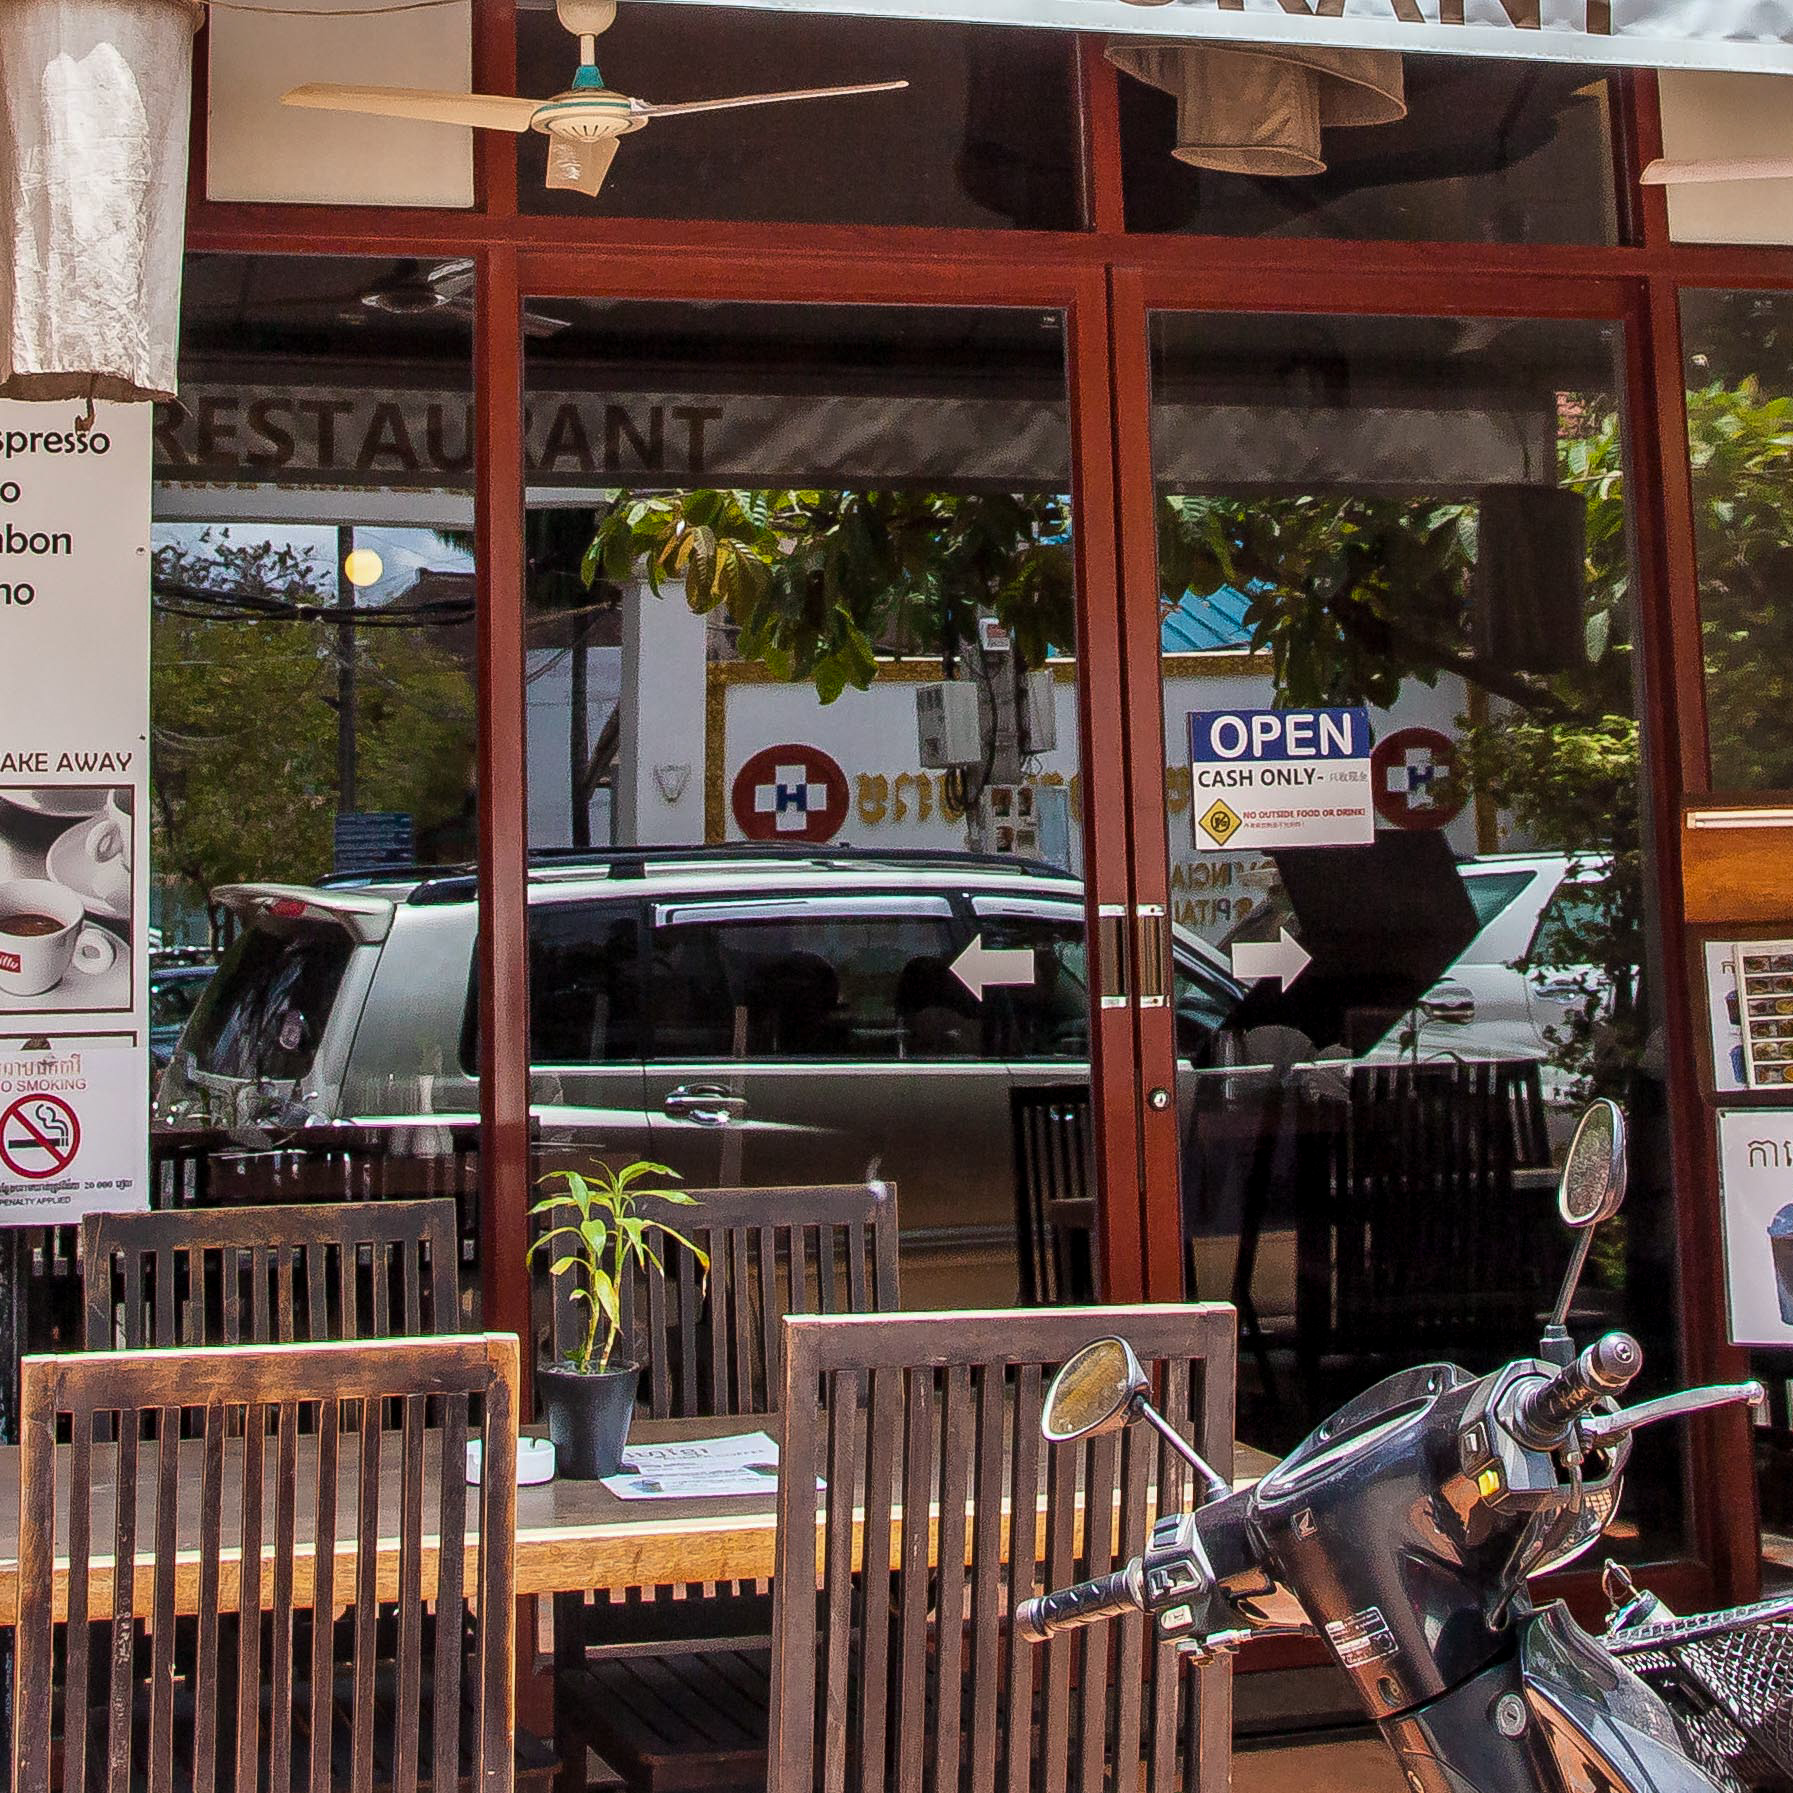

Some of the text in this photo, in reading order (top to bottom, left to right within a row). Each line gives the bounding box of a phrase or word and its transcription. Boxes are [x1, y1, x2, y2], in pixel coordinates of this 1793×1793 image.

[151, 396, 723, 473] RESTAUANT
[1210, 712, 1353, 758] OPEN
[56, 751, 132, 772] AWAY
[1198, 770, 1253, 787] CASH
[1258, 811, 1295, 819] OUTSIDE
[1297, 810, 1320, 818] FOOD
[16, 1078, 87, 1092] SMOKING
